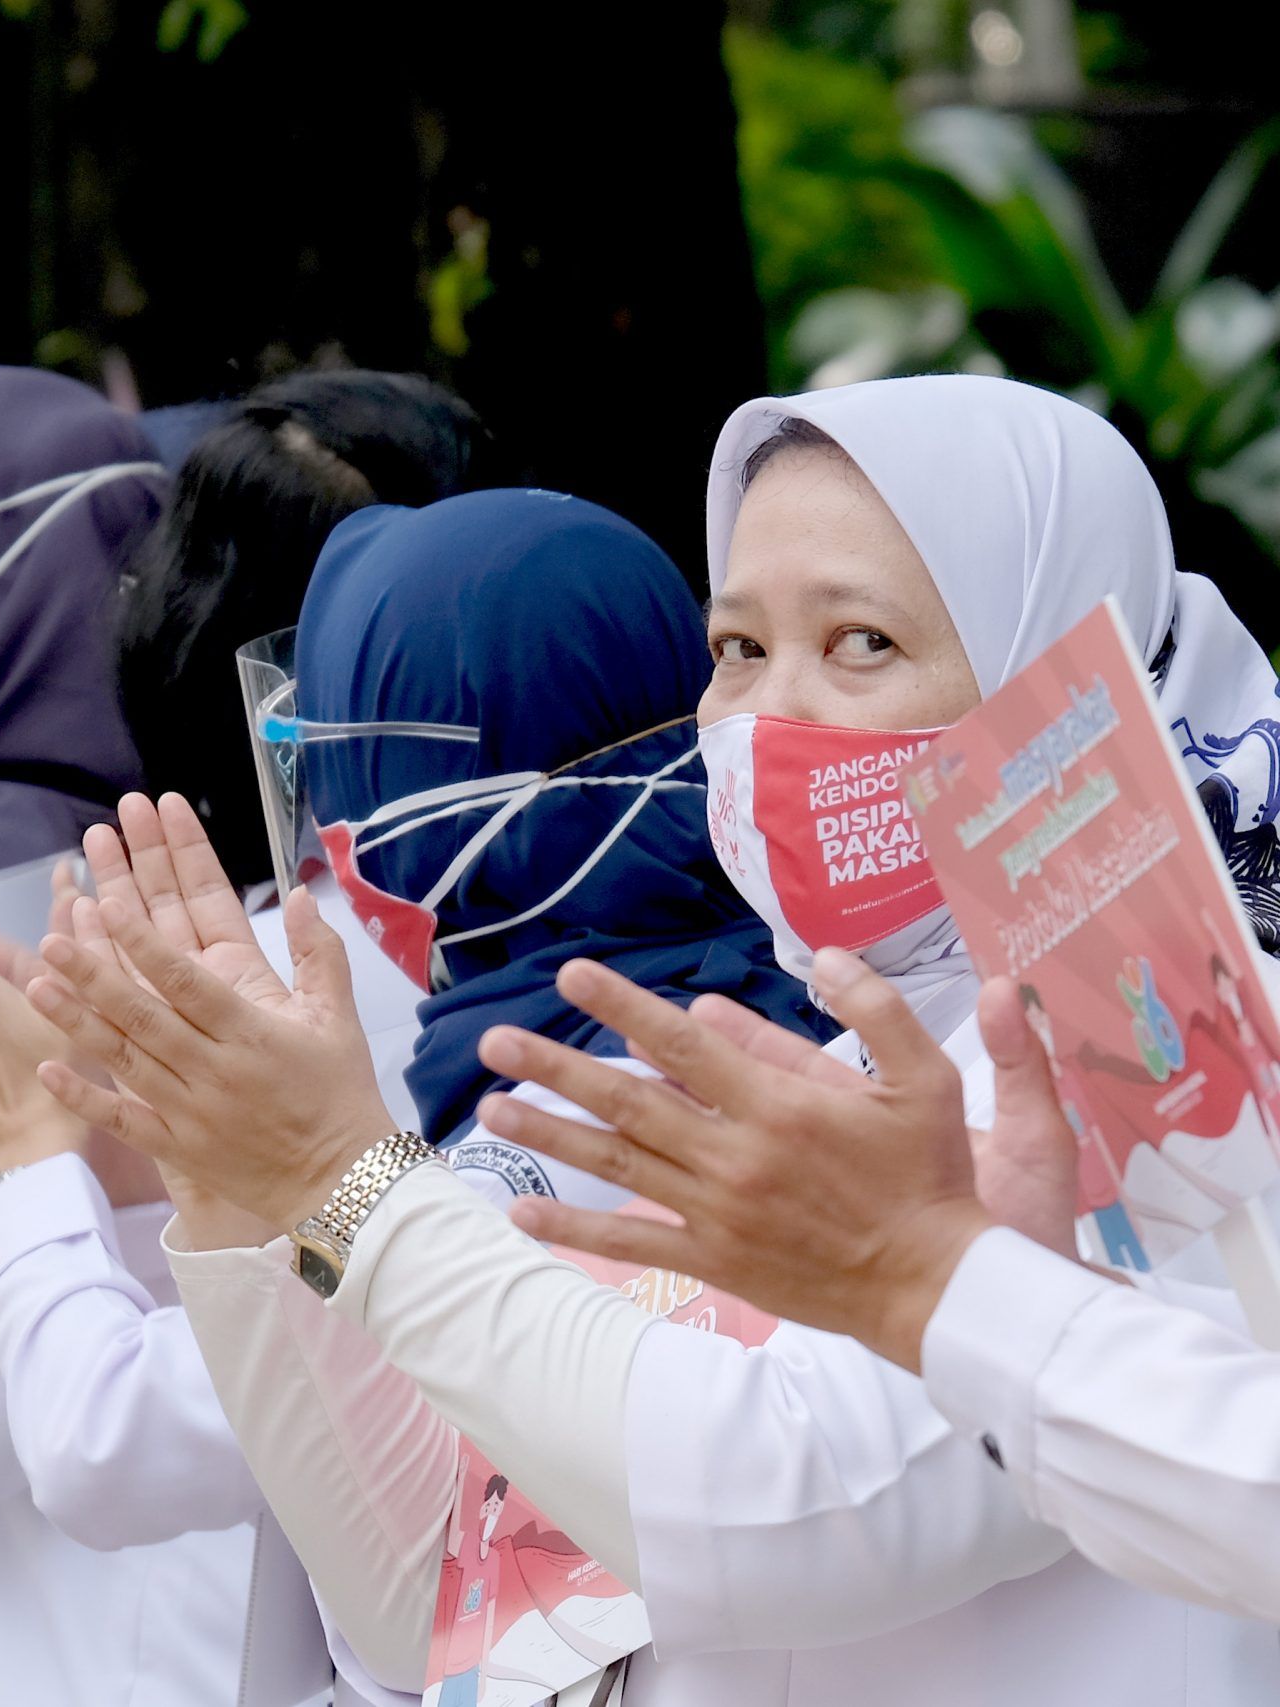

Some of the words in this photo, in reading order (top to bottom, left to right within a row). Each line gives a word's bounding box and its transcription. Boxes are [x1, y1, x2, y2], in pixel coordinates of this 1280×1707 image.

[809, 745, 913, 788] JANGAN
[829, 842, 928, 888] MASK
[521, 1166, 549, 1197] JEND
